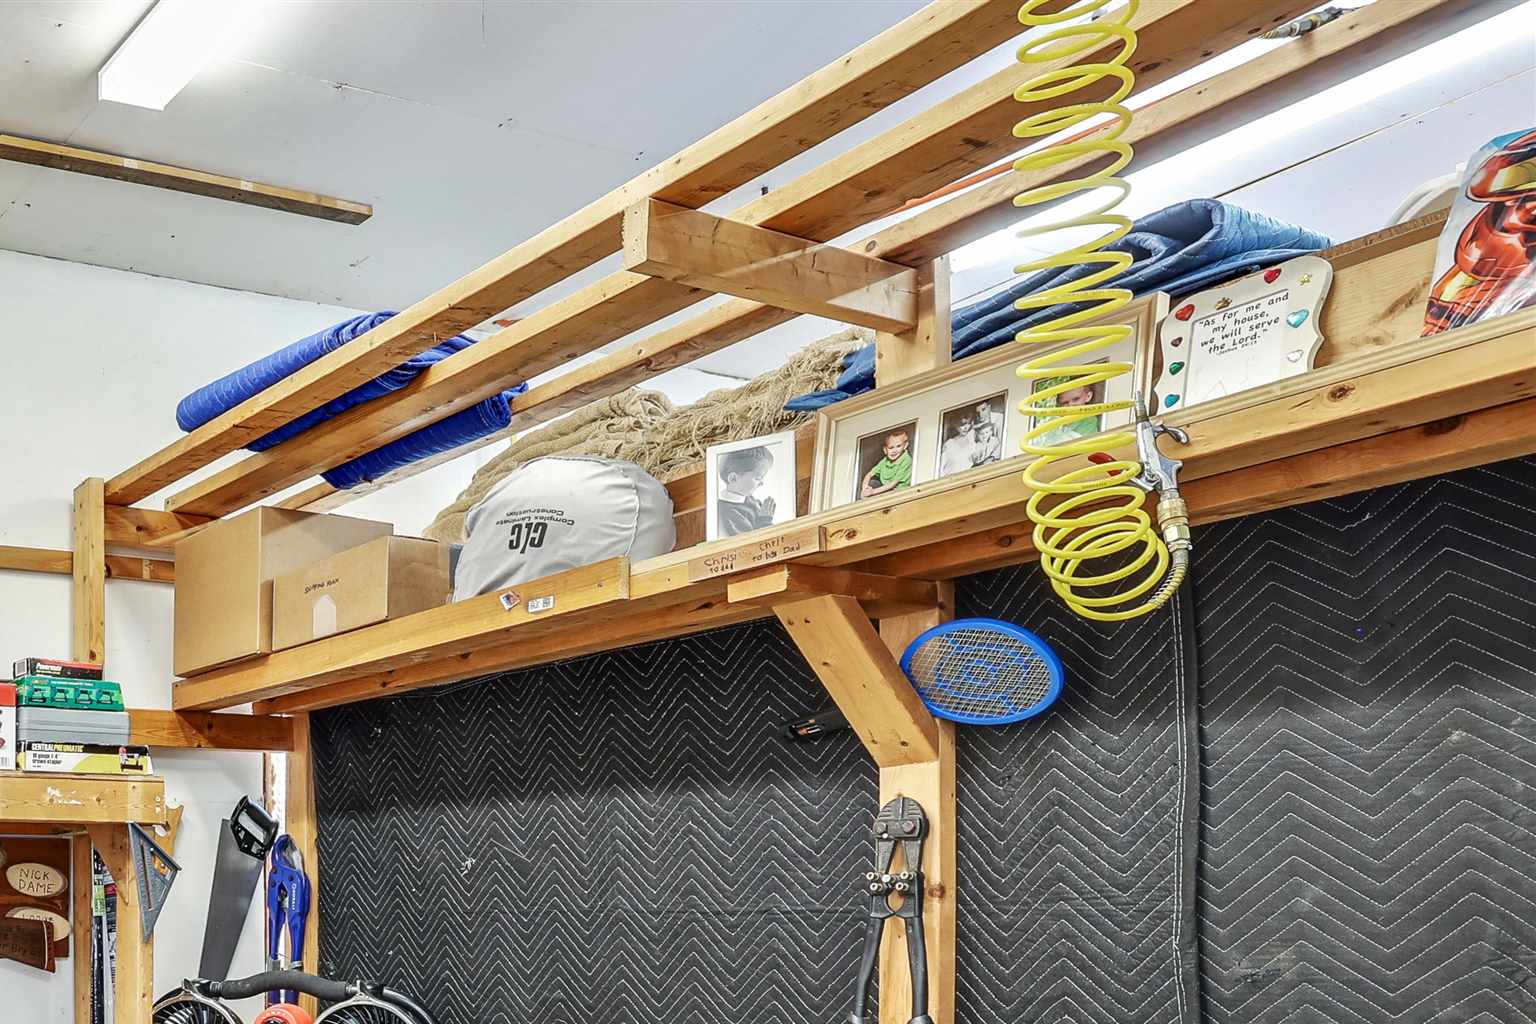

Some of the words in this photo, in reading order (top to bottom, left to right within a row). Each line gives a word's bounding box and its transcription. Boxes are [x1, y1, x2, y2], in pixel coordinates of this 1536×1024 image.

[1222, 310, 1239, 322] for
[1245, 302, 1261, 312] me
[1268, 292, 1289, 306] and
[1212, 325, 1227, 334] my
[1234, 312, 1269, 325] house,
[1200, 338, 1218, 348] we
[1221, 327, 1242, 341] will
[1249, 316, 1280, 331] serve
[1208, 343, 1225, 354] the
[506, 508, 564, 517] Construction
[535, 515, 575, 526] Complex
[19, 868, 50, 881] NICK
[18, 880, 55, 894] DAME
